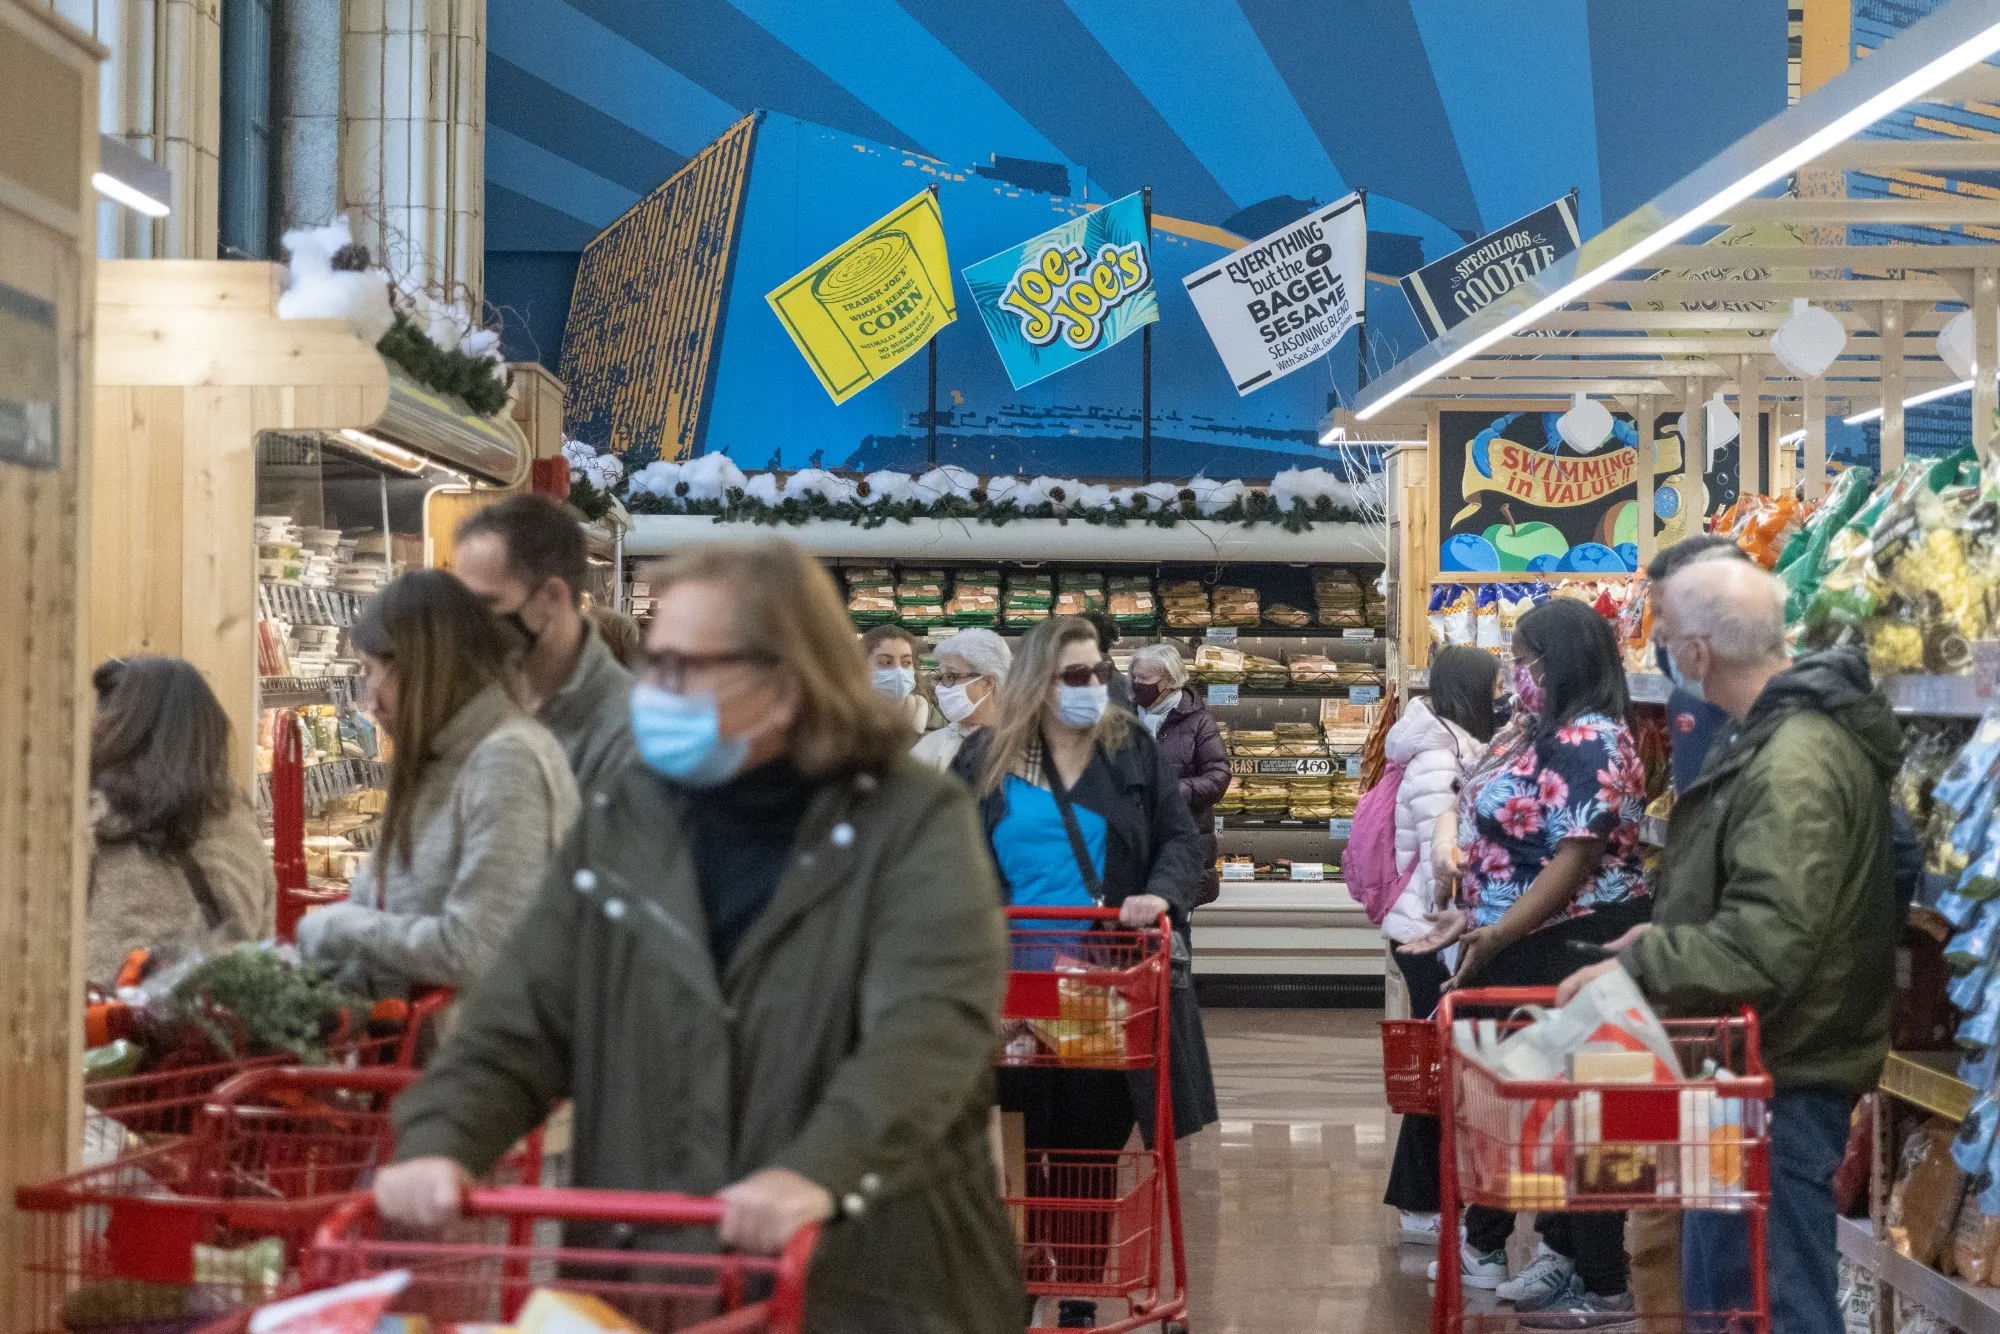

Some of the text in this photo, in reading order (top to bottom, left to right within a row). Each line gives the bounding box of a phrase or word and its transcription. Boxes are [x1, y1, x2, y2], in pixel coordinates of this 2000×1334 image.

[1225, 221, 1324, 284] EVERYTHING
[1455, 230, 1532, 280] SPECULOOS
[1246, 265, 1342, 324] BAGEL
[1248, 260, 1306, 296] but the
[842, 289, 884, 312] TRADER
[849, 278, 916, 322] WHOLE KERNEL
[858, 286, 923, 336] CORN
[1259, 282, 1346, 344] SESAME
[859, 333, 896, 349] NATURALLY
[897, 315, 920, 335] SWEET
[878, 312, 931, 355] NO SUGAR ADDED
[891, 315, 935, 356] PRESERVATIVES
[1268, 299, 1350, 360] SEASONING BLEND
[1276, 357, 1296, 371] With
[1294, 351, 1309, 363] Sea
[1306, 343, 1324, 357] Salt,
[1322, 331, 1338, 347] Garlic
[1501, 446, 1636, 483] SWIMMING
[1506, 471, 1533, 498] in
